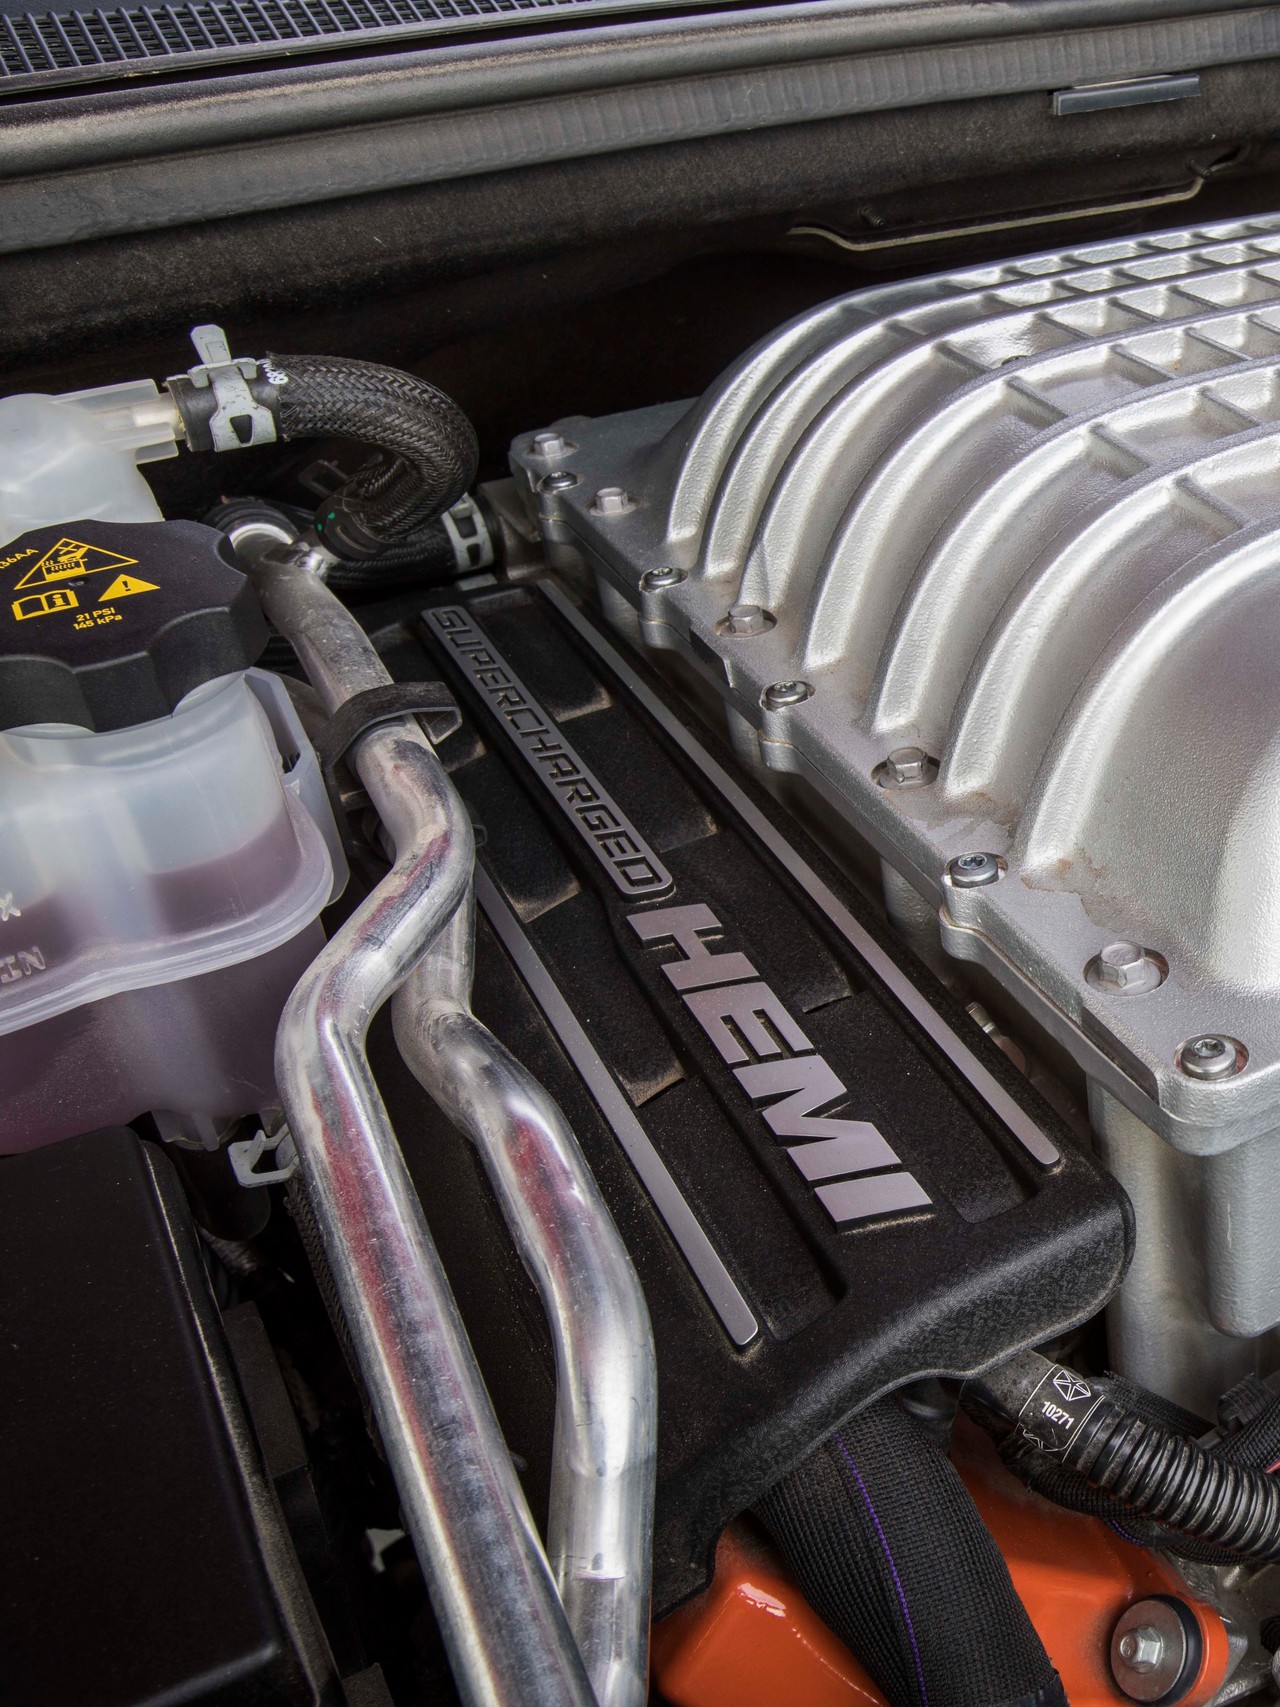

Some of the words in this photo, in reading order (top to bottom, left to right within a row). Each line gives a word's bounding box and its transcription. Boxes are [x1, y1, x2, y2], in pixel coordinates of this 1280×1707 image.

[73, 619, 95, 630] 145
[96, 614, 123, 625] kPa
[76, 612, 90, 622] 21
[92, 607, 116, 618] PSI
[429, 608, 664, 889] SUPERCHARGED
[625, 902, 934, 1223] HEMI
[1040, 1400, 1075, 1430] 10271
